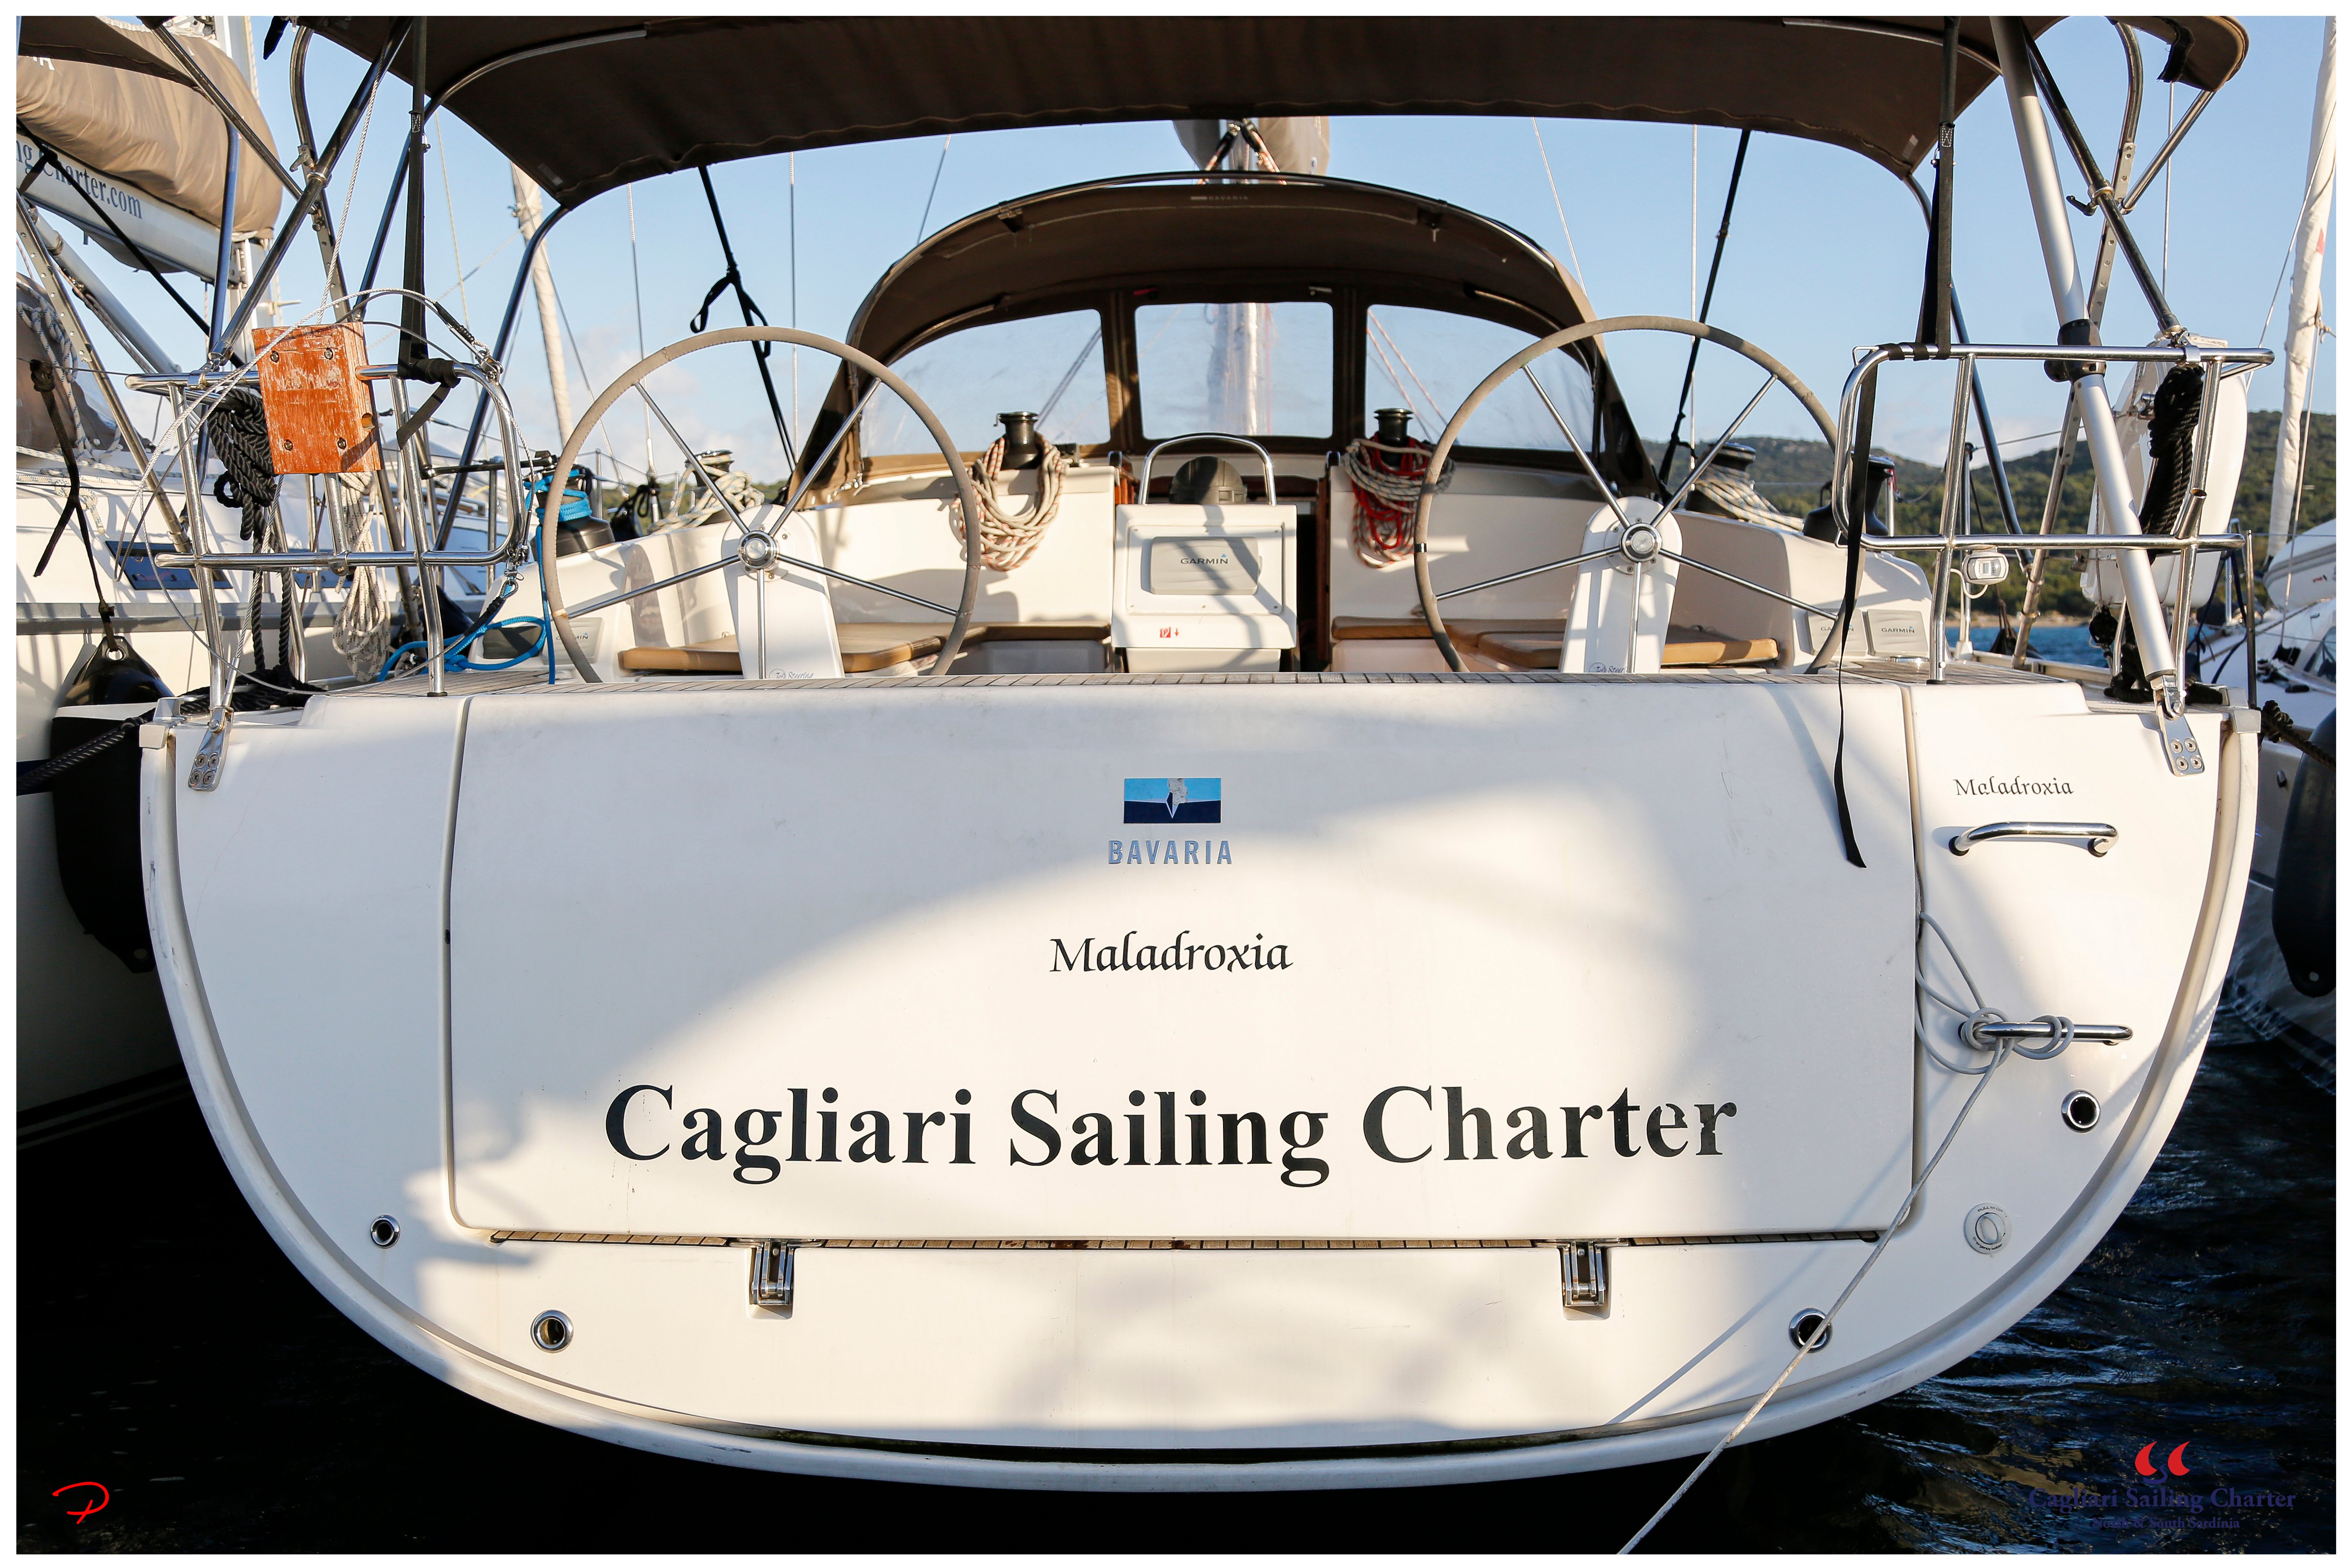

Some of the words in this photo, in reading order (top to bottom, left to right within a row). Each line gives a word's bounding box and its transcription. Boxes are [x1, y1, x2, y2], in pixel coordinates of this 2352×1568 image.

[1953, 775, 2074, 795] Maladroxia
[1108, 840, 1232, 864] BAVARIA
[1049, 930, 1294, 972] Maladroxia
[606, 1085, 975, 1184] Cagliari
[1011, 1089, 1329, 1187] Sailing
[1363, 1085, 1737, 1163] Charter
